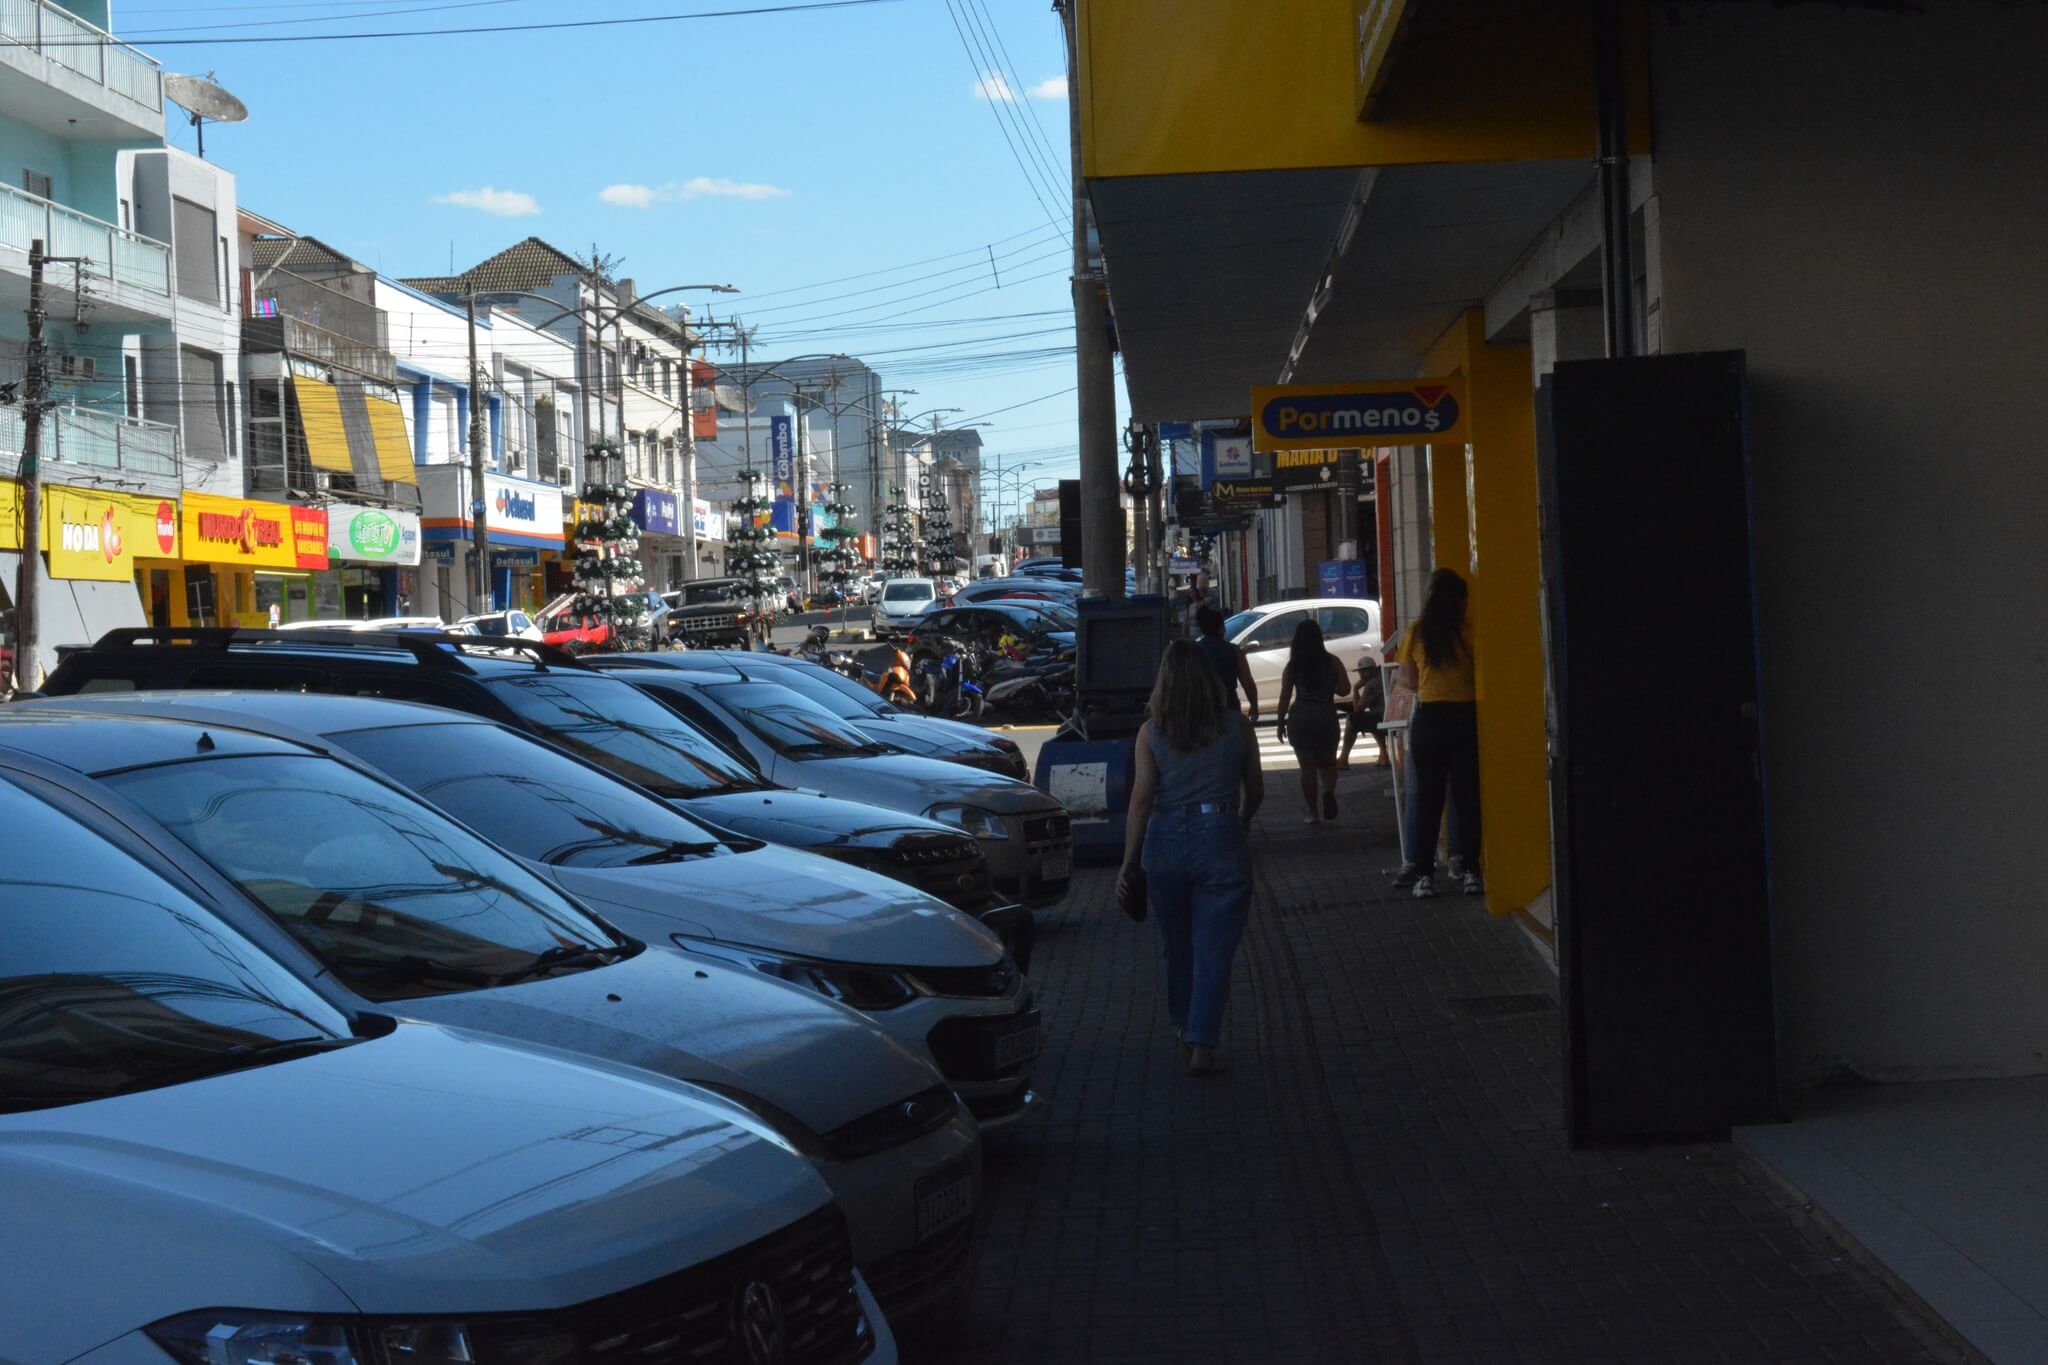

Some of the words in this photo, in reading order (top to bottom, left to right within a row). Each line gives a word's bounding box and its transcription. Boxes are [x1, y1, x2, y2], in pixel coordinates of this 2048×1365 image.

[778, 422, 789, 480] Colombo
[1276, 450, 1326, 468] MANIA
[505, 488, 535, 521] Deltasul
[920, 464, 931, 520] HOTEL
[63, 523, 100, 552] MODA
[199, 512, 245, 540] MUNDO
[255, 519, 281, 544] REAL
[496, 557, 533, 566] Deltasul
